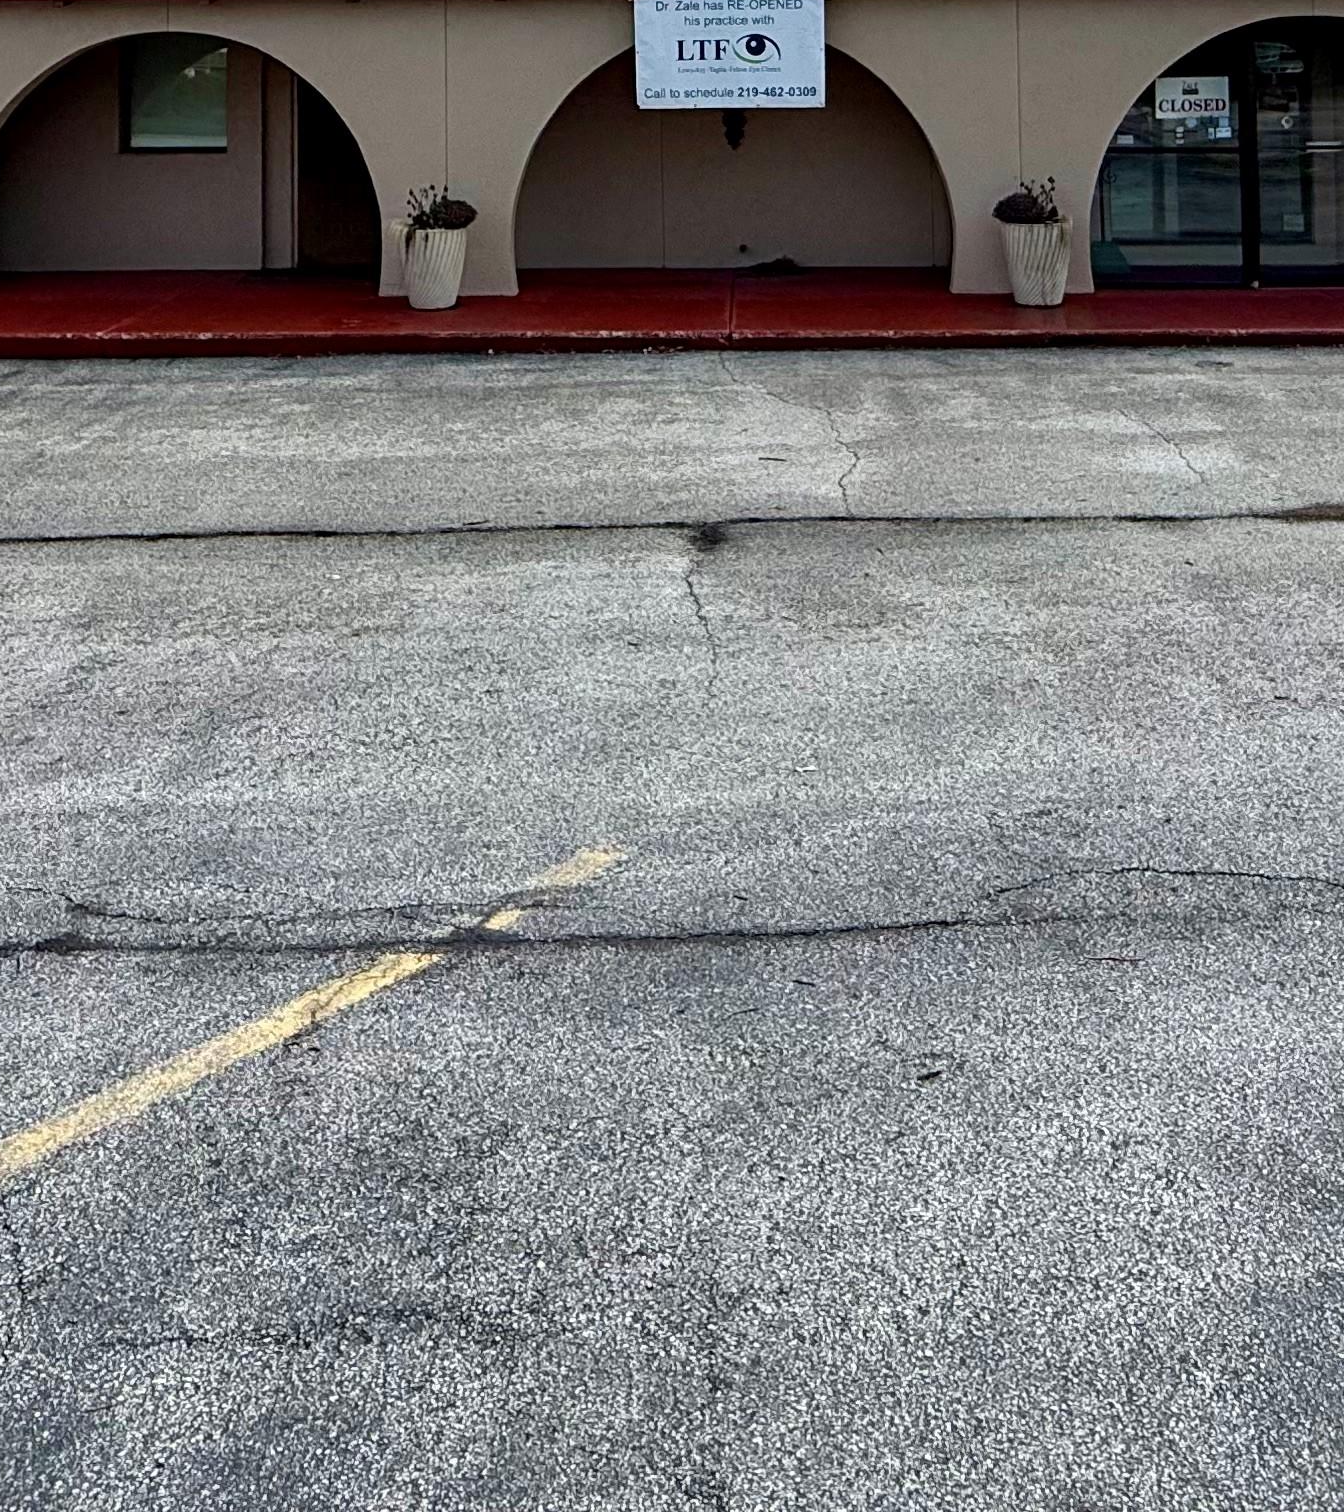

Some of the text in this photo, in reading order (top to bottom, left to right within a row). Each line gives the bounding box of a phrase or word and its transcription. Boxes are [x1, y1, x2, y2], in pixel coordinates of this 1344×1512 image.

[674, 0, 700, 11] Zale
[703, 0, 724, 10] has
[727, 0, 803, 10] RE-OPENED
[684, 14, 775, 28] his practice with
[676, 39, 730, 61] LTF
[644, 86, 817, 99] Call to schedule 219-462-0309
[1158, 98, 1227, 113] CLOSED
